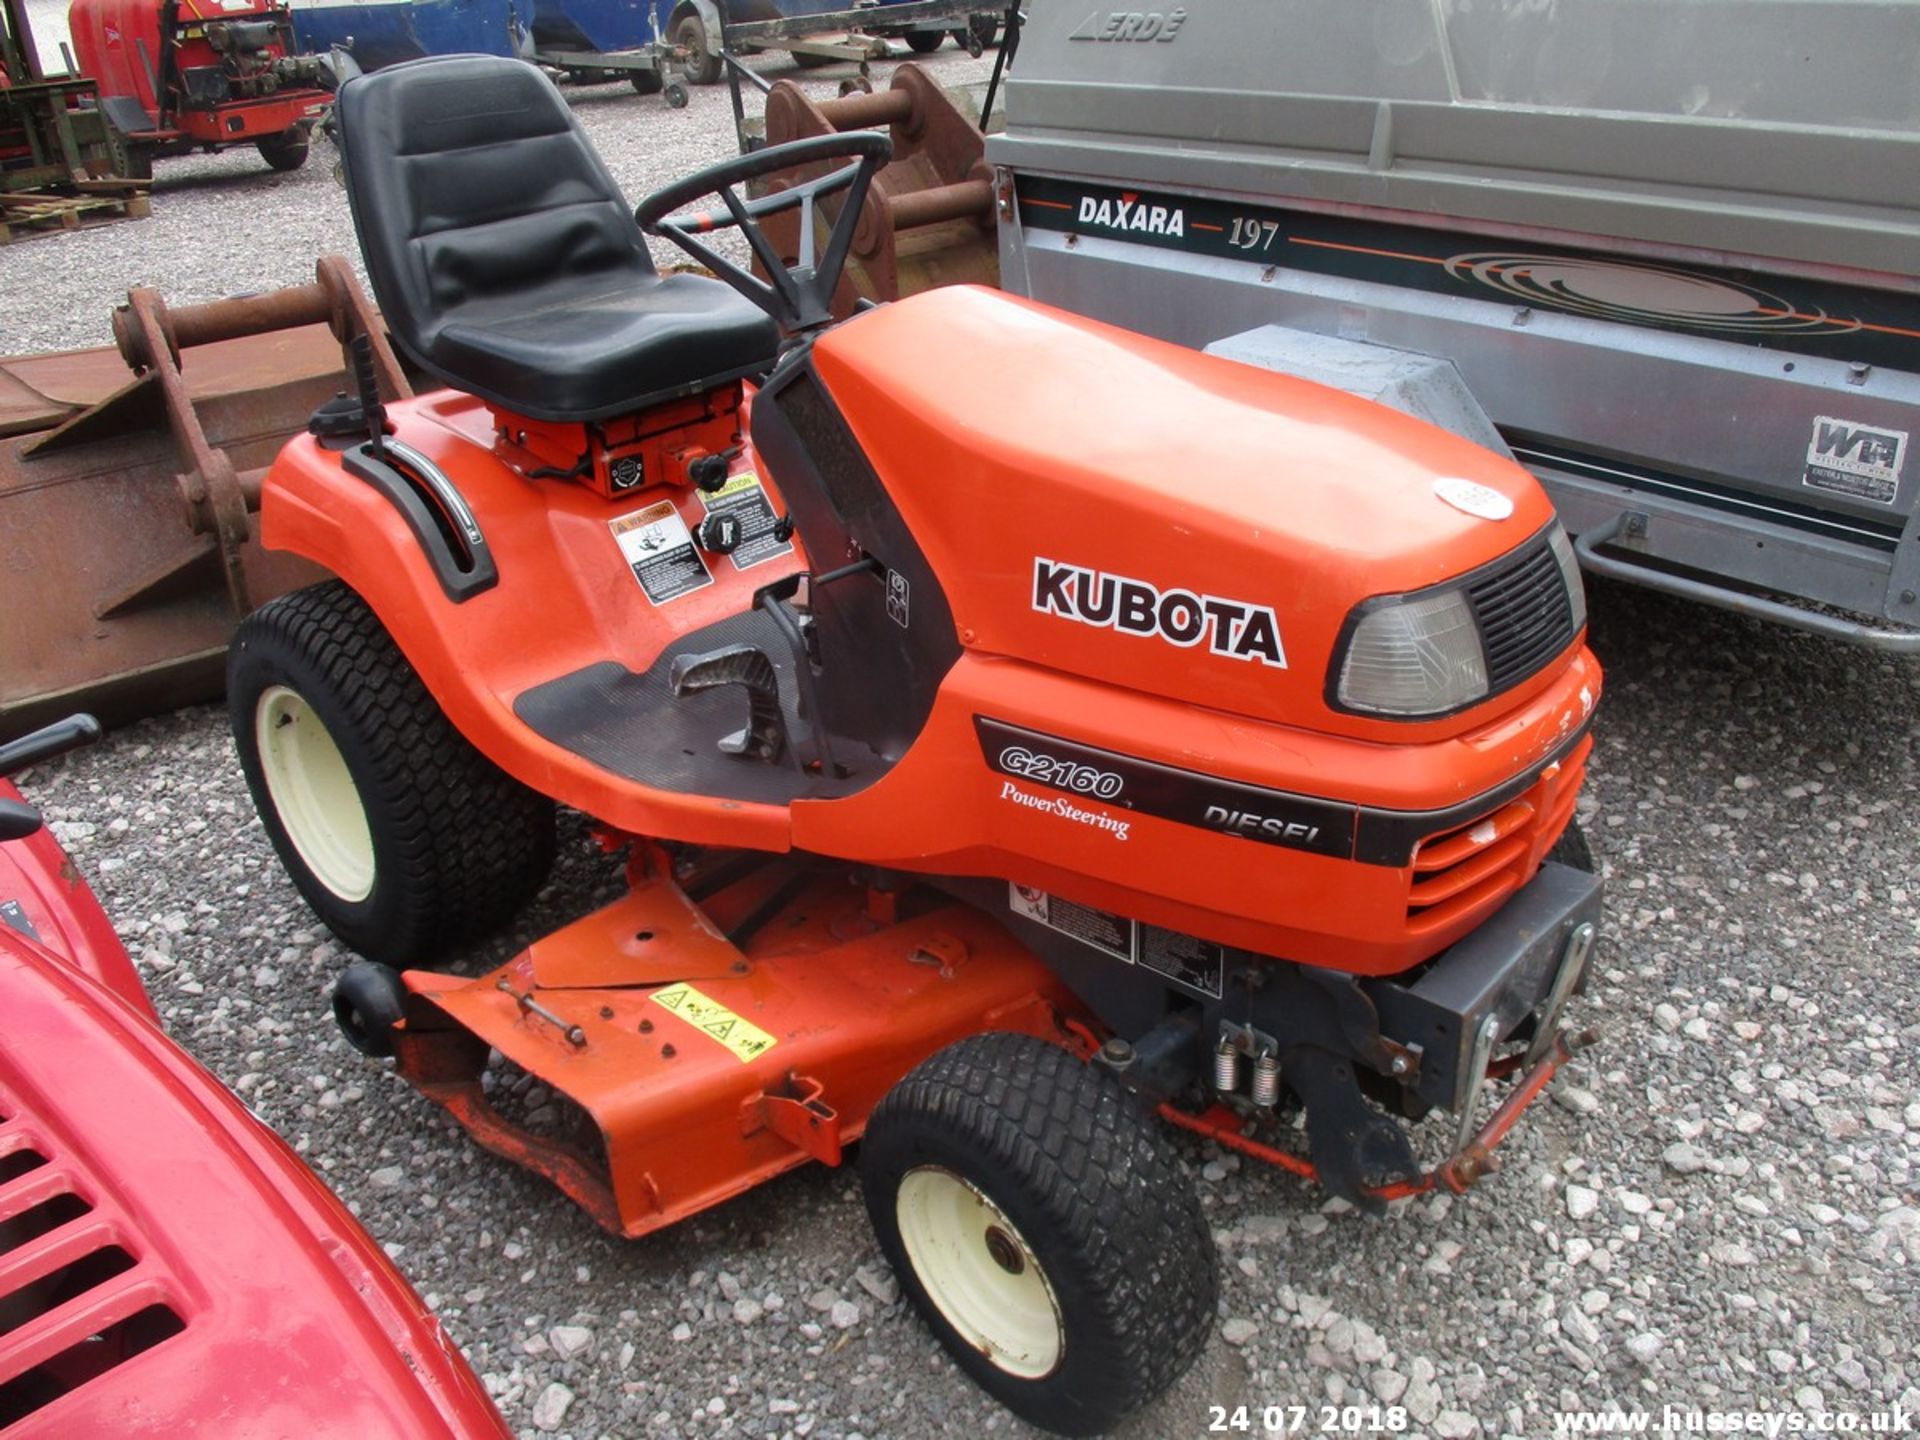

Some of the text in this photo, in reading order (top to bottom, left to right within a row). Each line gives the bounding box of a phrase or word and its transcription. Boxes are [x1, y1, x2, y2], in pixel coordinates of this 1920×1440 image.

[1078, 196, 1280, 251] DAXARA 197
[1032, 556, 1288, 669] KUBOTA
[999, 746, 1123, 798] G2160
[1000, 781, 1130, 840] PowerSteering
